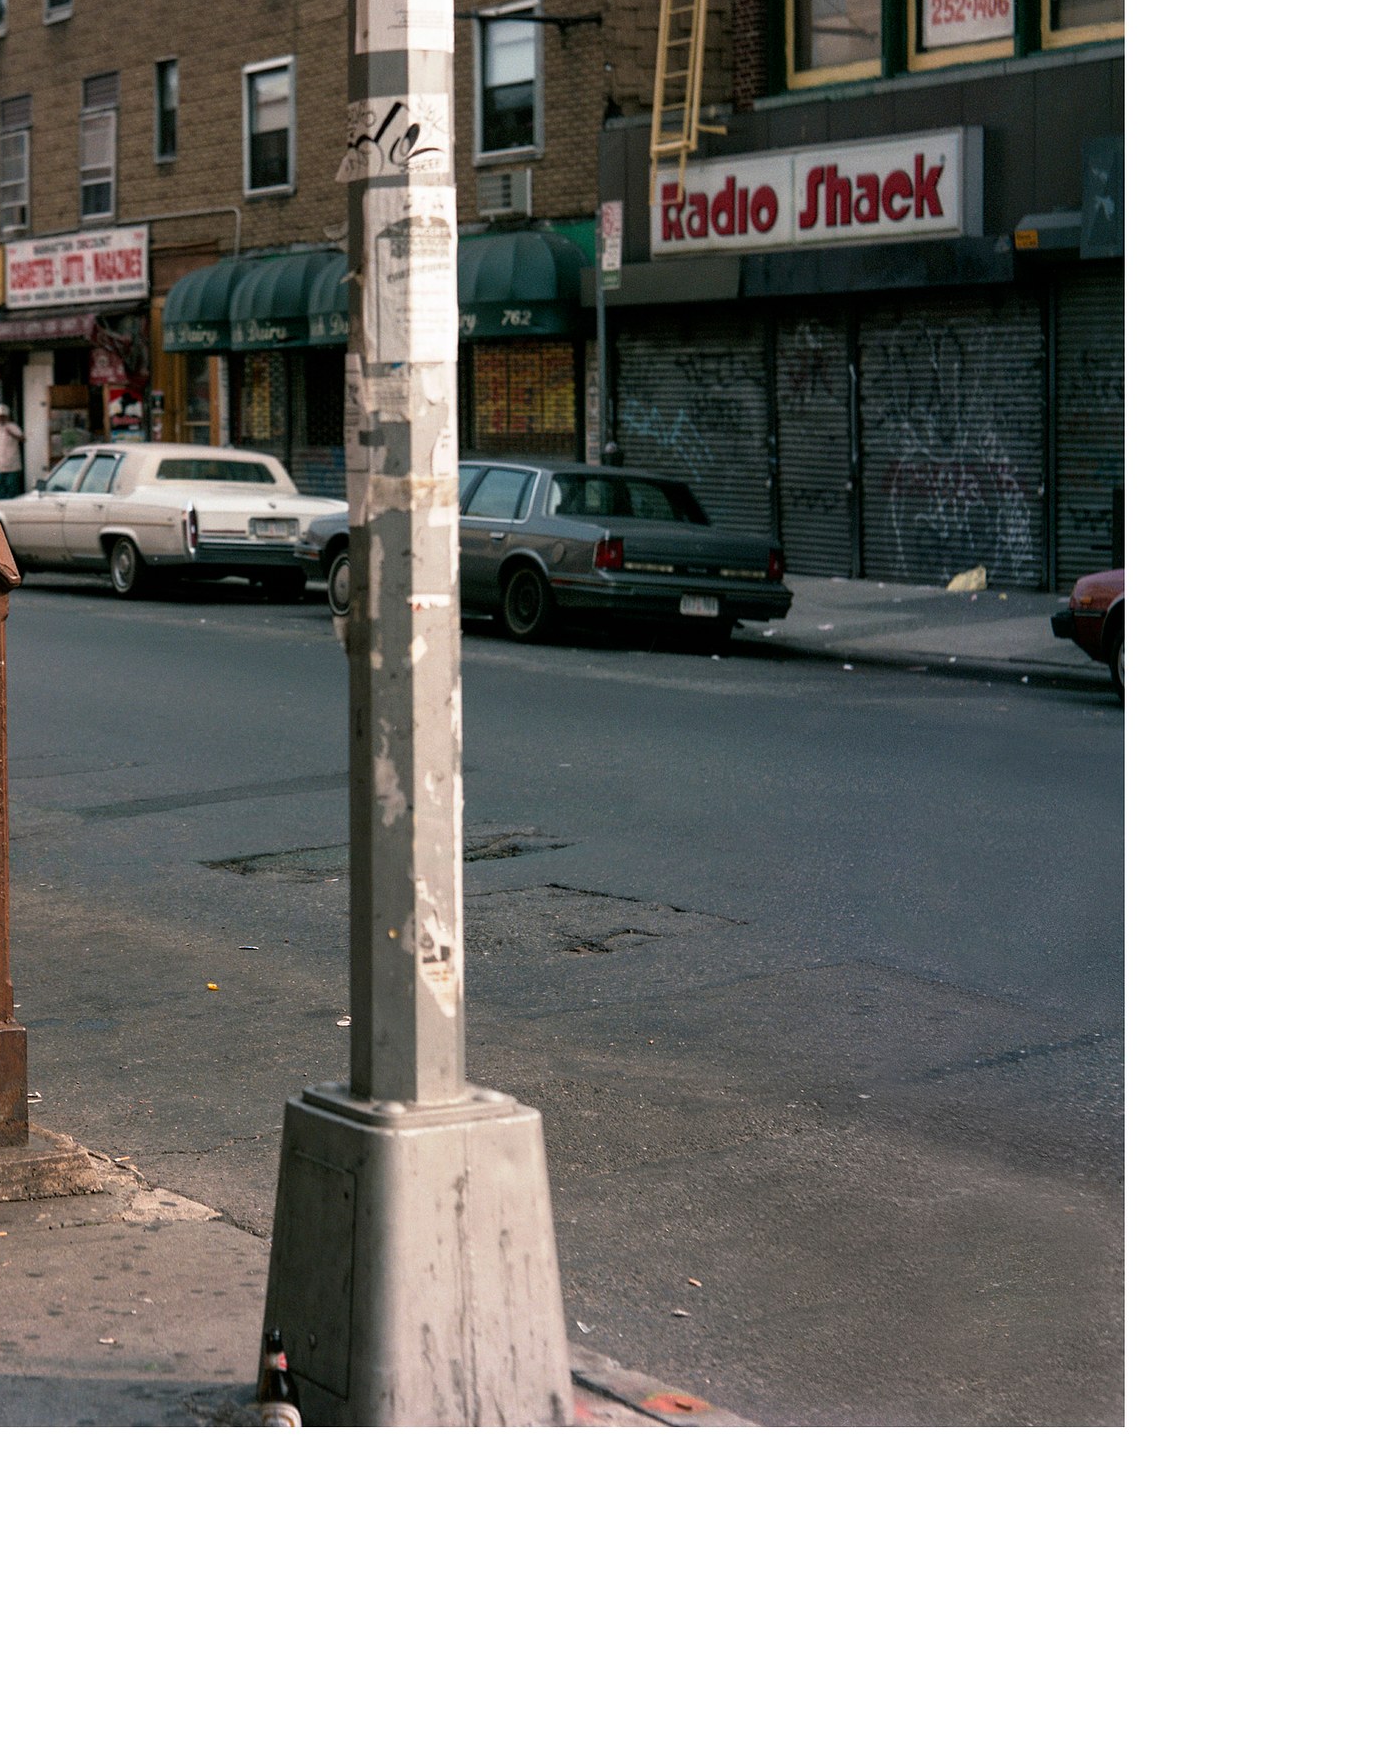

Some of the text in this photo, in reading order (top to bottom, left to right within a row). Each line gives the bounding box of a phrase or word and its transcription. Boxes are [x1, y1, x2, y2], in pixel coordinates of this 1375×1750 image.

[661, 153, 946, 241] Radio Shack
[501, 310, 532, 326] 762
